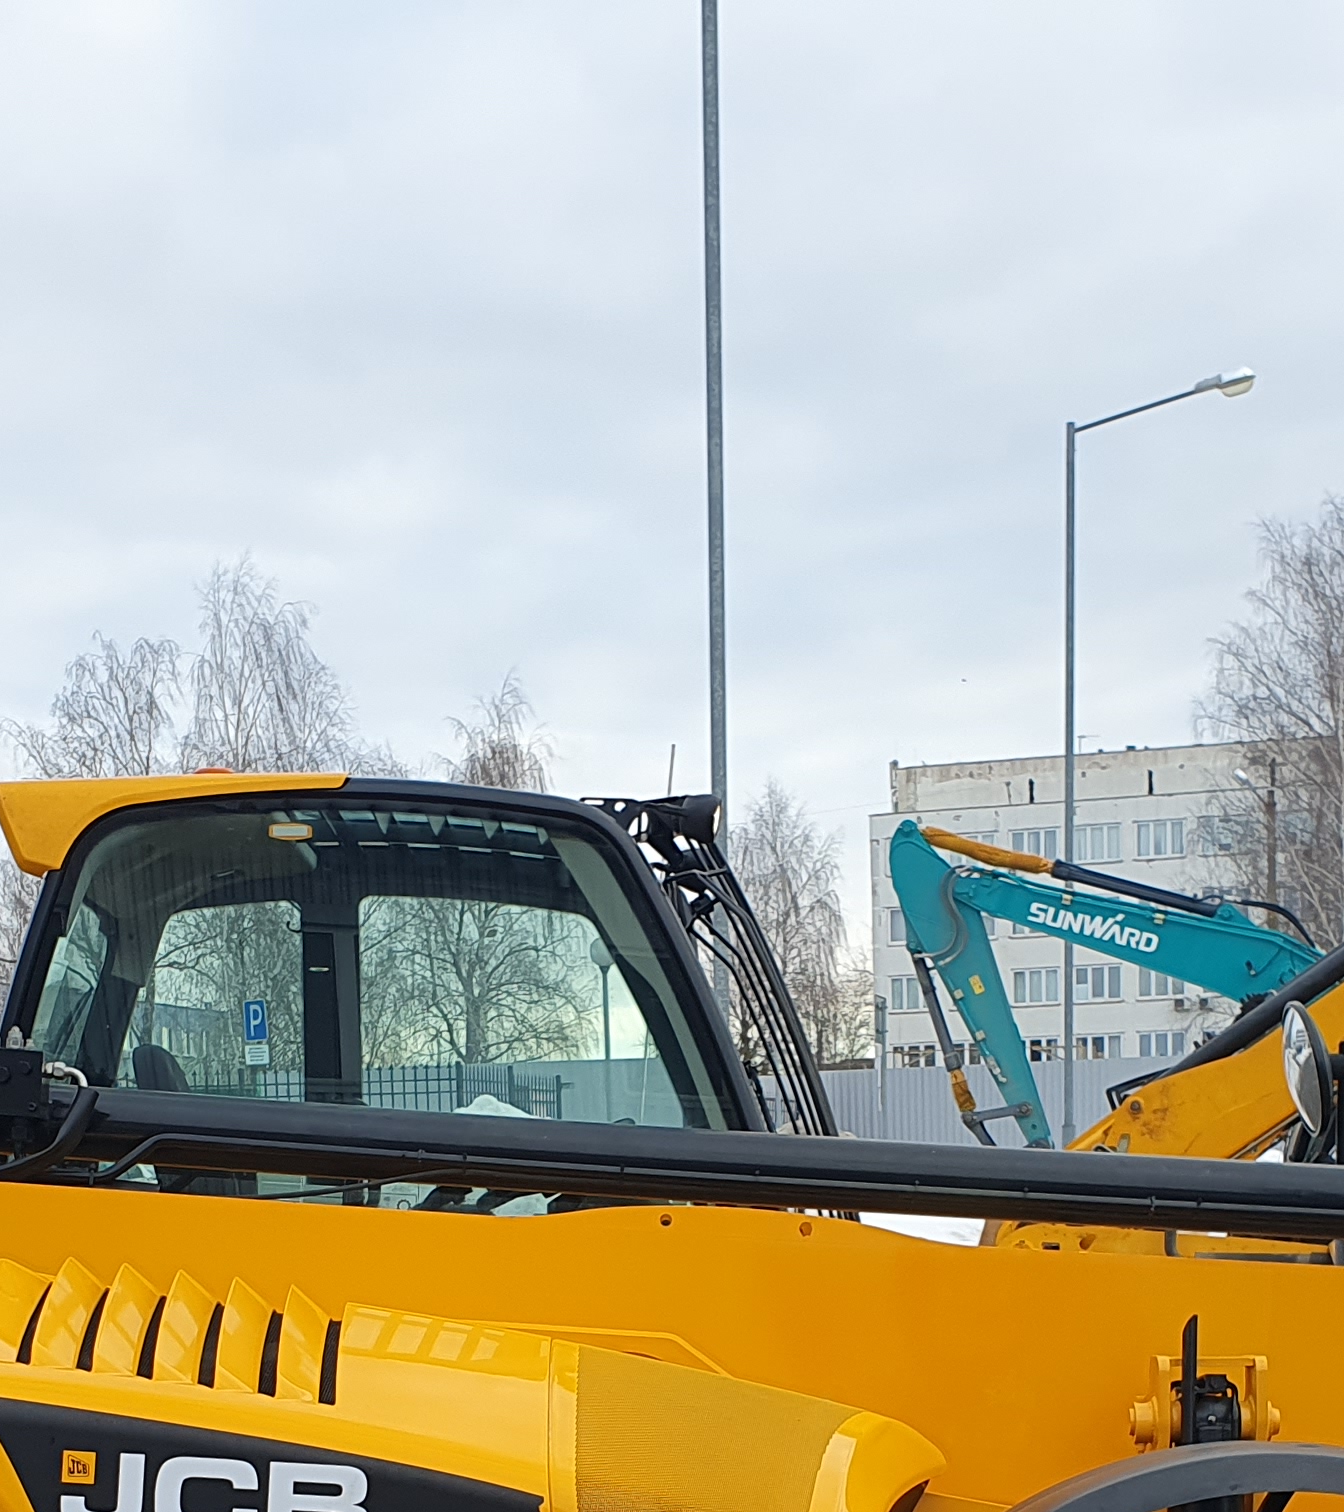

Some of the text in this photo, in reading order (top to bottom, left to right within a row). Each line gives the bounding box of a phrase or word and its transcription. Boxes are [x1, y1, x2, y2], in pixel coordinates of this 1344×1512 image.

[1027, 902, 1159, 953] SUNWARD
[249, 1004, 262, 1037] P
[68, 1458, 88, 1475] JCB
